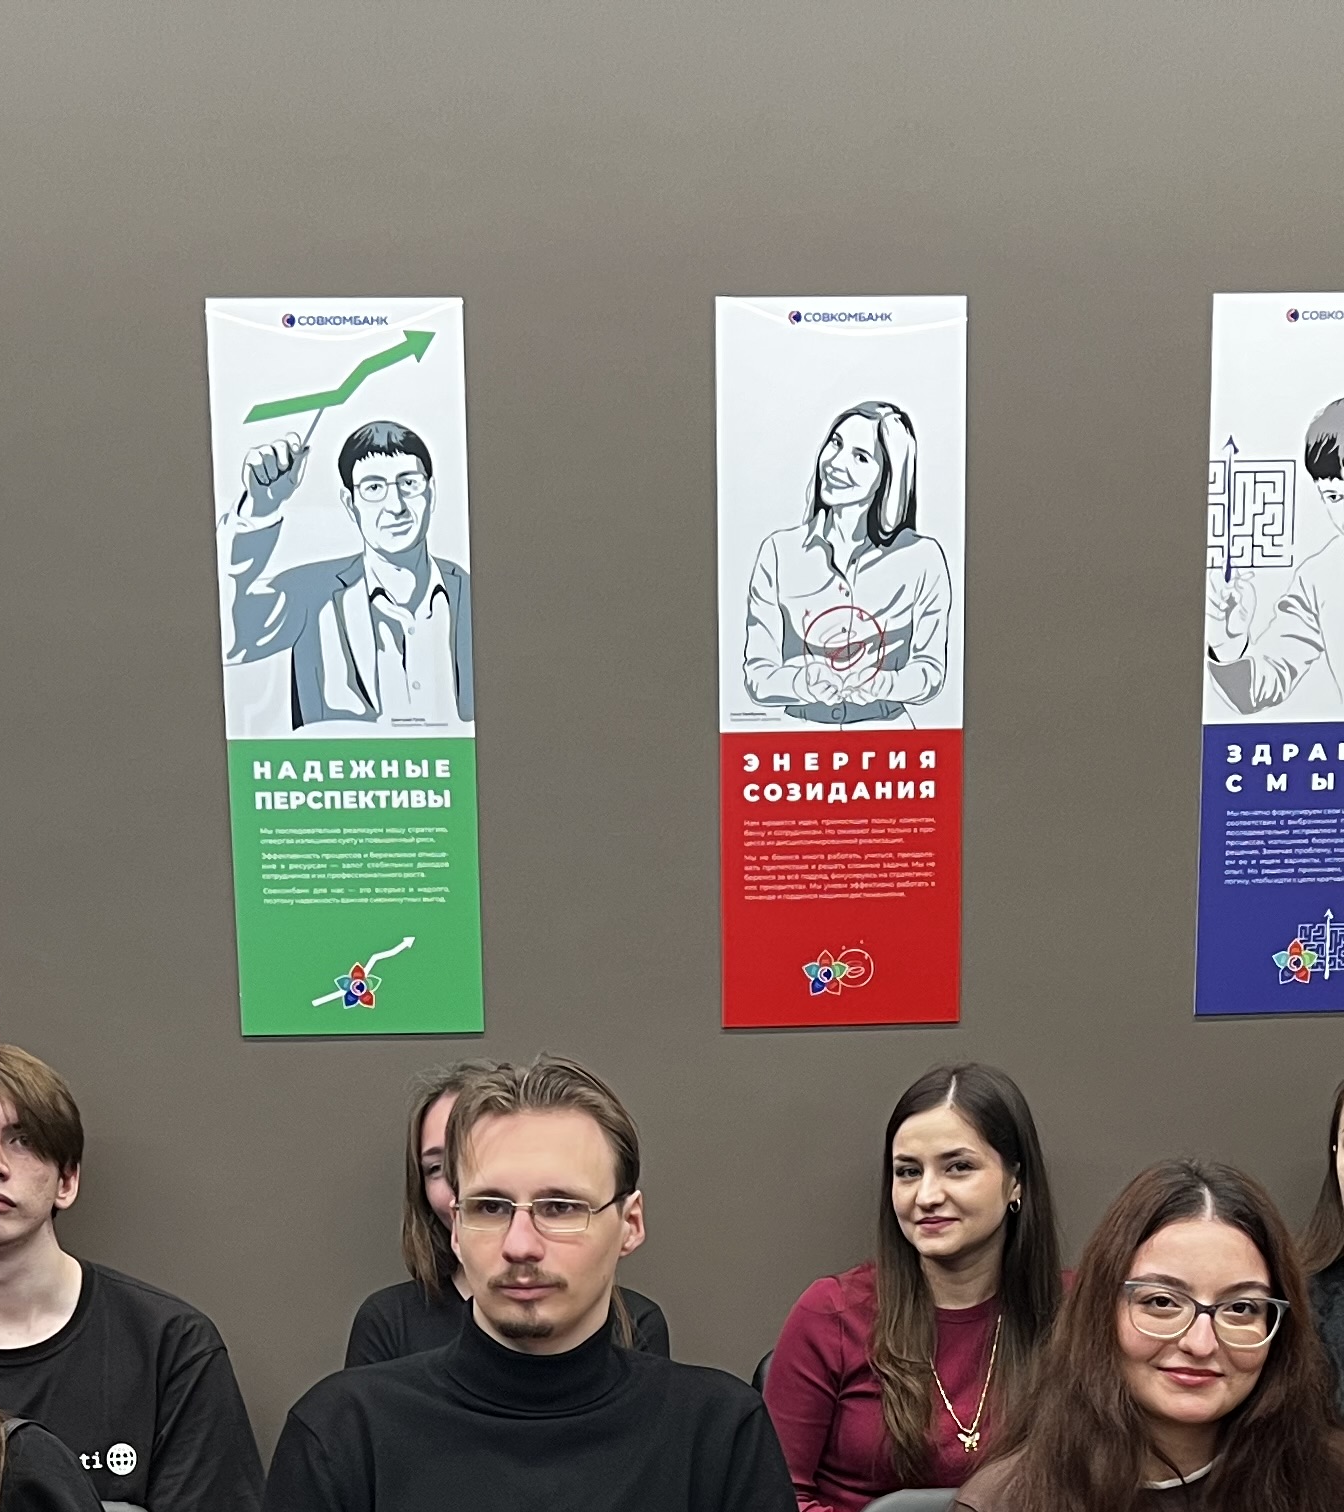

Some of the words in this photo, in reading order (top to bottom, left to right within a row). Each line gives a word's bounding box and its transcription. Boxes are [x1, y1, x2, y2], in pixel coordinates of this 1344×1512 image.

[297, 315, 389, 326] СОВКОМБАНК
[803, 312, 893, 322] СОВКОМБАНК
[253, 759, 451, 782] НАДЕЖНЫЕ
[743, 750, 936, 772] ЭНЕРГИЯ
[254, 790, 451, 810] ПЕРСПЕКТИВЫ
[743, 781, 936, 804] СОЗИДАНИЯ
